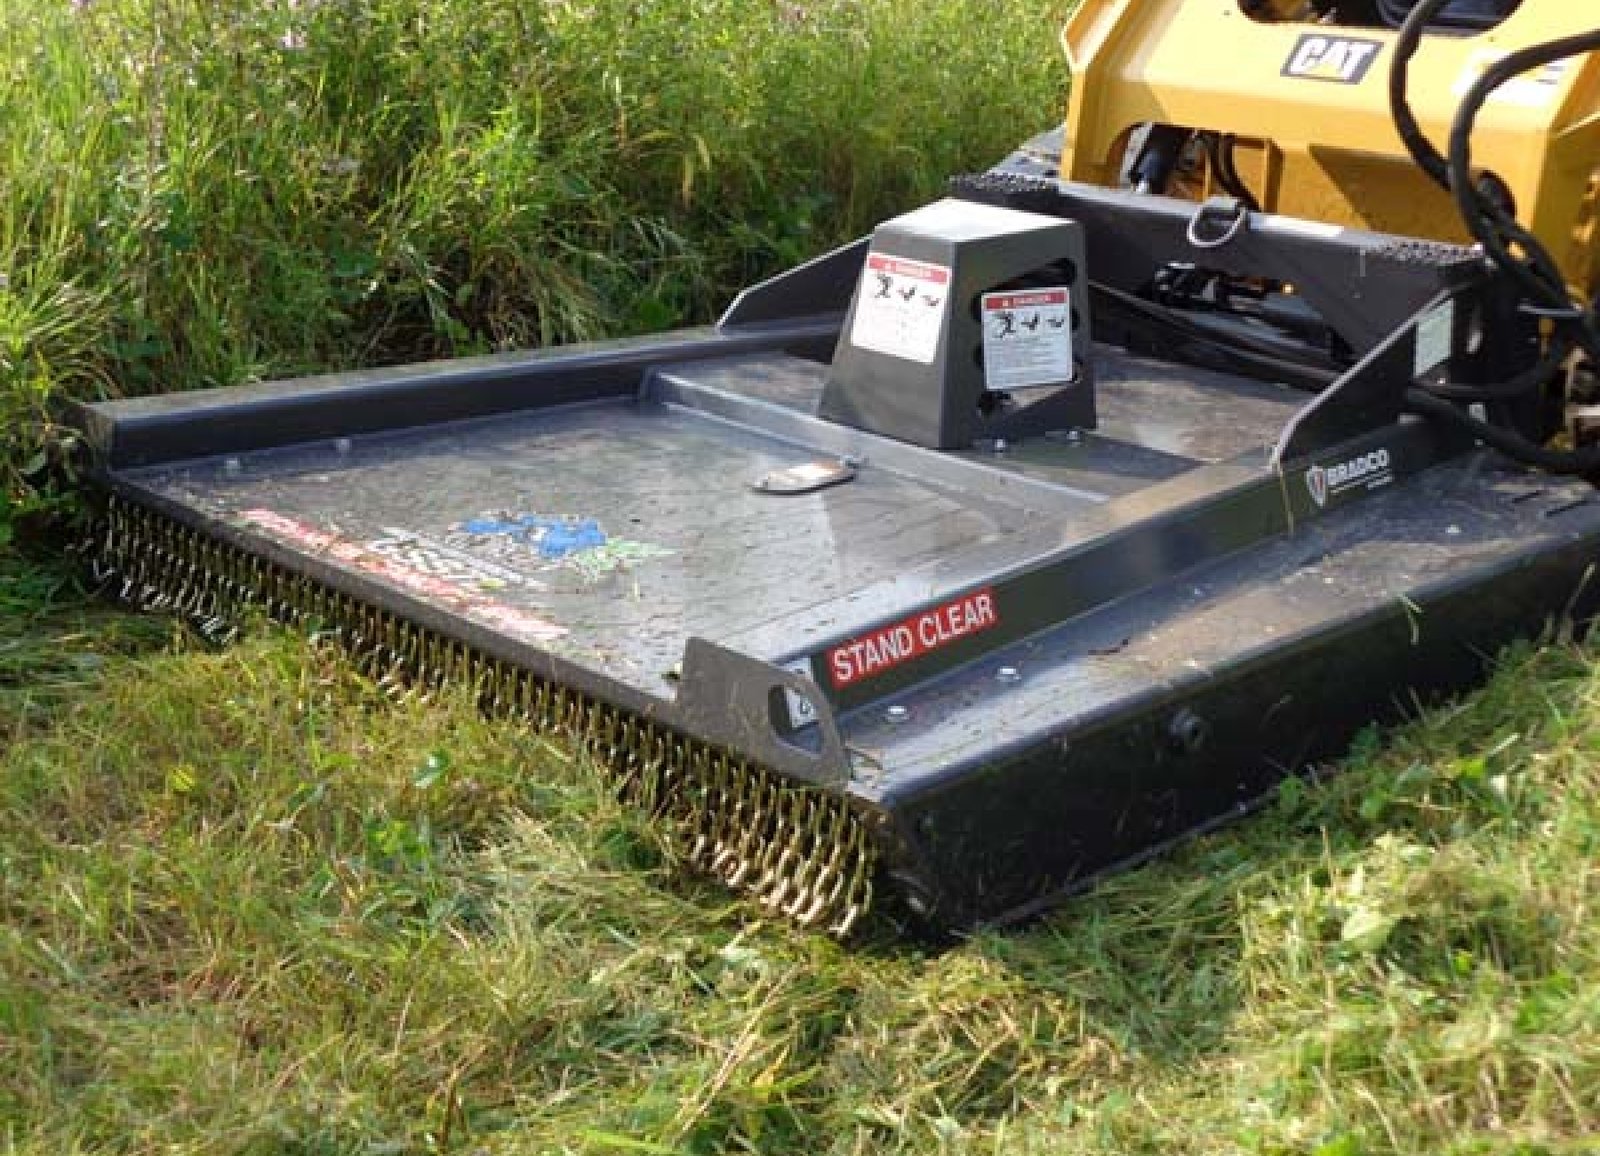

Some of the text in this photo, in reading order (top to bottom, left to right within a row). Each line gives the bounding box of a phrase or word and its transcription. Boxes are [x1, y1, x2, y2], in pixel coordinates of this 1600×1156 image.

[1289, 37, 1376, 78] CAT
[833, 593, 994, 681] STAND CLEAR
